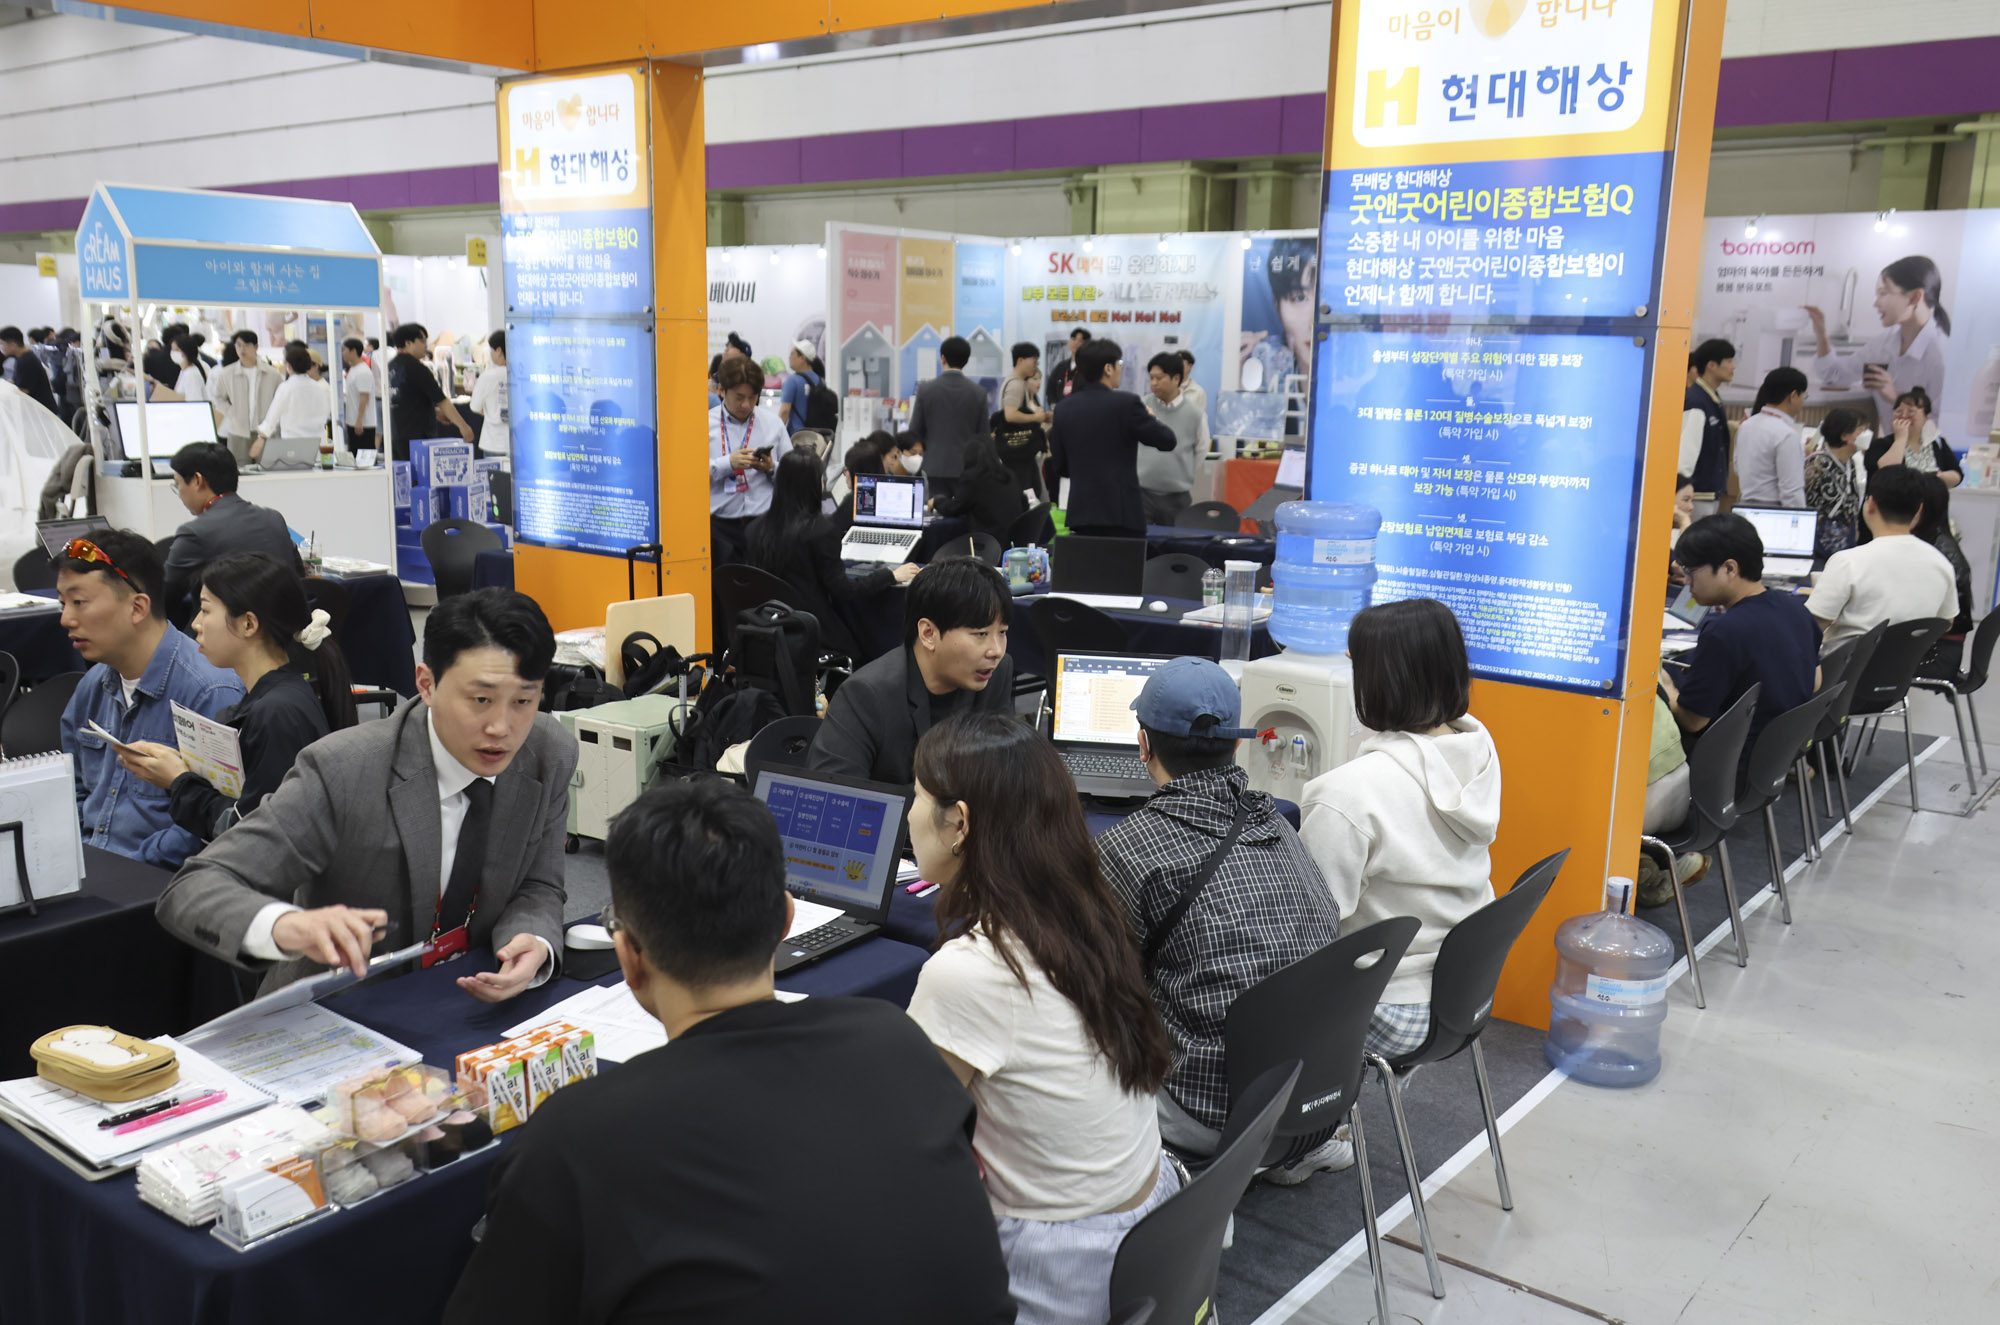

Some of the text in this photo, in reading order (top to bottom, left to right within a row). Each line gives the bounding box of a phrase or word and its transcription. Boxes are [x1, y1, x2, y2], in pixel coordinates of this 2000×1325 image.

[1389, 0, 1617, 41] 마음이 합니다
[1442, 60, 1633, 122] 현대해상
[522, 102, 620, 131] 마음이 합니다
[550, 149, 629, 185] 현대해상
[1350, 168, 1452, 191] 무배당 현대해상
[1349, 182, 1634, 225] 굿앤굿어린이종합보험Q
[1347, 225, 1565, 252] 소중한 내 아이를 위한 마음
[205, 259, 245, 276] 아이와
[250, 261, 275, 277] 함께
[280, 263, 305, 279] 사는
[576, 253, 593, 269] 위한
[594, 253, 612, 269] 마음
[1346, 257, 1415, 280] 현대해상
[1418, 252, 1625, 279] 굿앤굿어린이종합보험이
[85, 266, 122, 291] HAUS
[235, 278, 300, 294] 크림하우스
[517, 272, 548, 288] 현대해상
[1344, 283, 1497, 306] 언제나 함께 합니다.
[1111, 310, 1132, 323] No!
[1135, 310, 1156, 323] No!
[1159, 310, 1182, 323] No!
[1372, 350, 1583, 368] 출생부터 성장단계별 주요 위험에 대한 집중 보장
[1442, 368, 1503, 382] (특약 가입 시)
[1357, 406, 1373, 419] 3대
[1375, 407, 1402, 421] 질병은
[1454, 410, 1533, 426] 질병수술보장으로
[1535, 413, 1566, 428] 폭넓게
[1568, 415, 1593, 430] 보장!
[1439, 426, 1499, 440] (특약 가입 시)
[1349, 462, 1591, 490] 증권 하나로 태아 및 자녀 보장은 물론 산모와 부양자까지
[1413, 482, 1517, 501] 보장 가능 (특약 가입 시)
[1425, 524, 1472, 540] 납입면제로
[1475, 527, 1504, 542] 보험료
[1506, 531, 1526, 545] 부담
[1528, 533, 1549, 547] 감소
[1429, 540, 1490, 557] (특약 가입 시)
